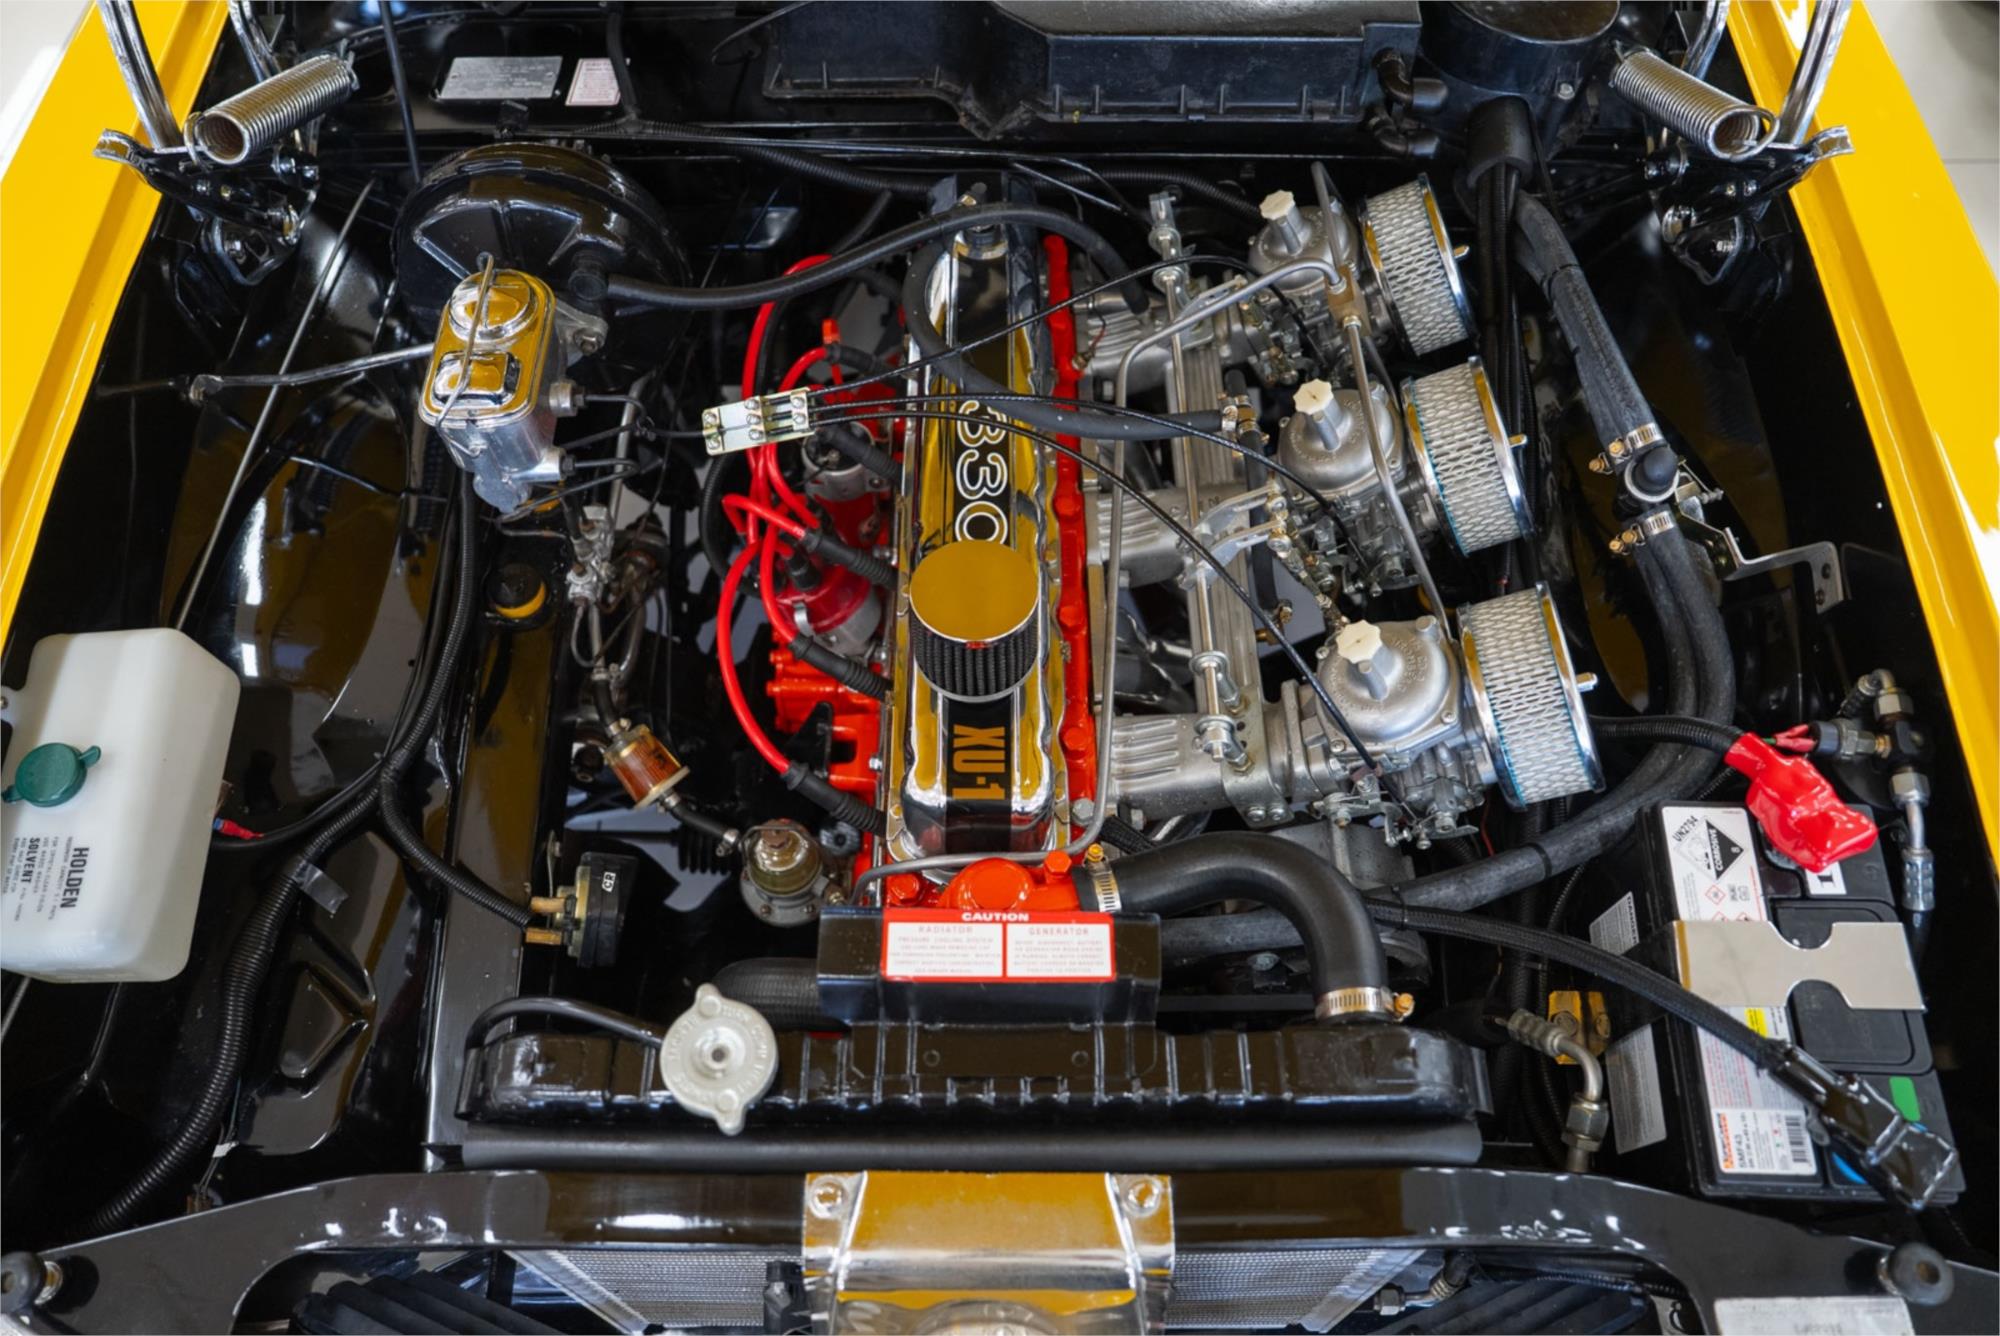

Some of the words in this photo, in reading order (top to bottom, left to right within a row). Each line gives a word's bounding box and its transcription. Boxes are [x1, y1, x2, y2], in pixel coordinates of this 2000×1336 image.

[952, 724, 1005, 800] XU-1
[1672, 815, 1698, 842] UN2794
[21, 837, 40, 883] SOLVENT
[1709, 829, 1723, 871] CORROSIVE
[60, 847, 90, 908] HOLDEN
[603, 873, 615, 889] CR
[918, 926, 973, 934] RADIATOR
[961, 912, 1029, 922] CAUTION
[1028, 927, 1089, 935] GENERATOR
